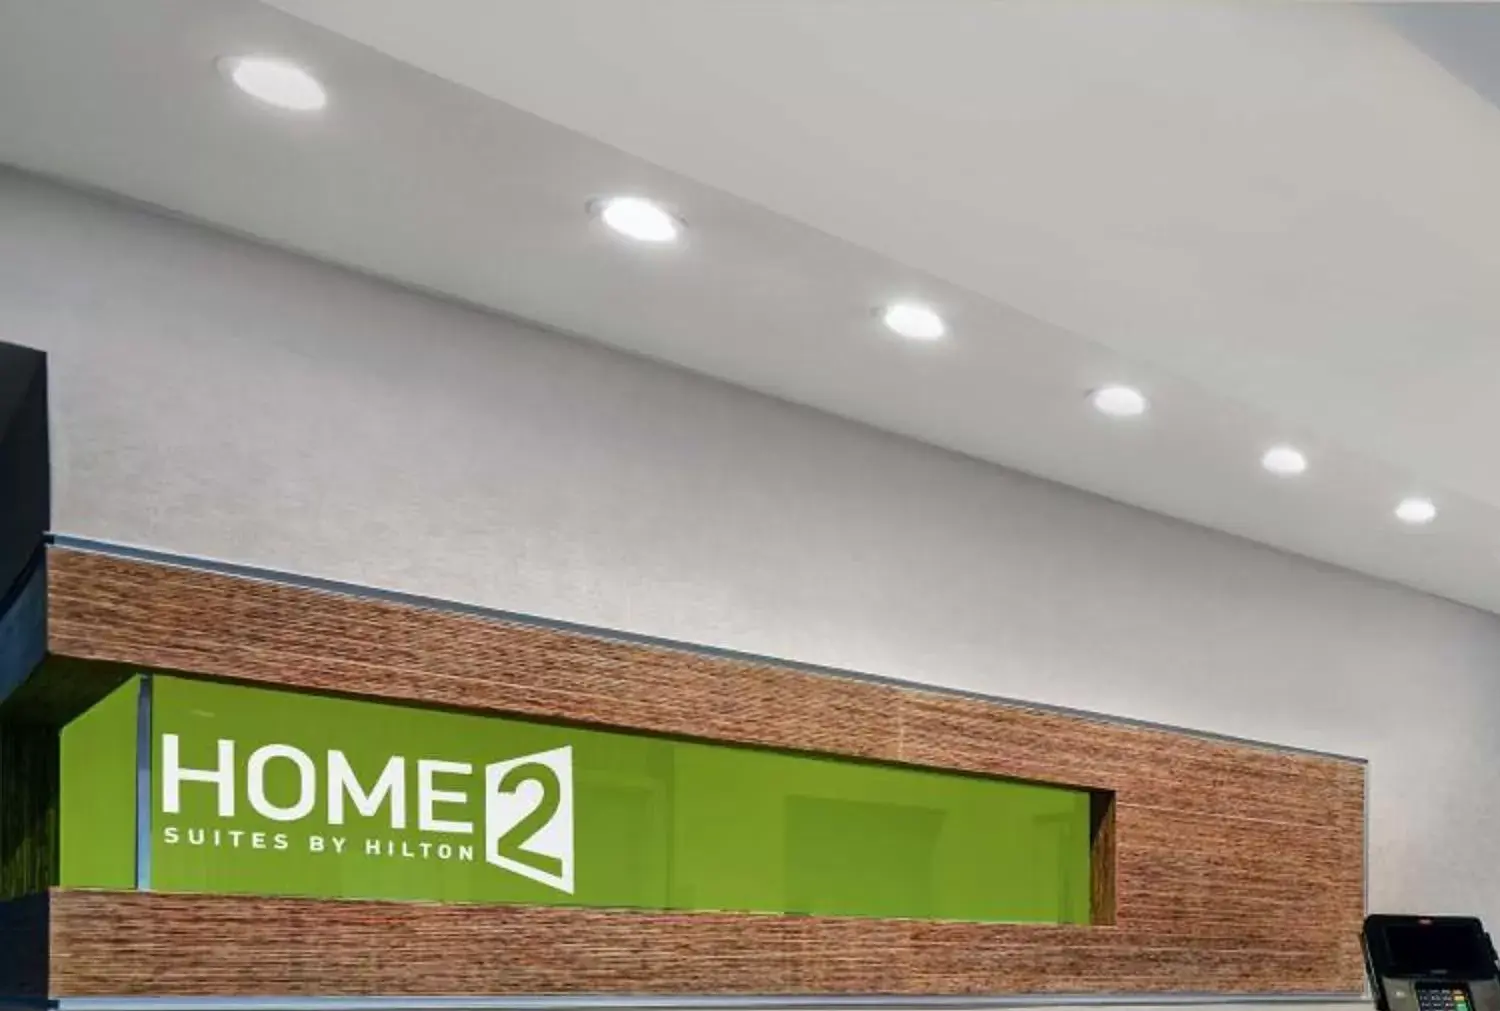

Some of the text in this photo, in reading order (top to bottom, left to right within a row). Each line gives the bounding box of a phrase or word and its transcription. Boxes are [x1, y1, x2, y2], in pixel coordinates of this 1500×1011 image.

[163, 827, 474, 861] SUITES BY HILTON
